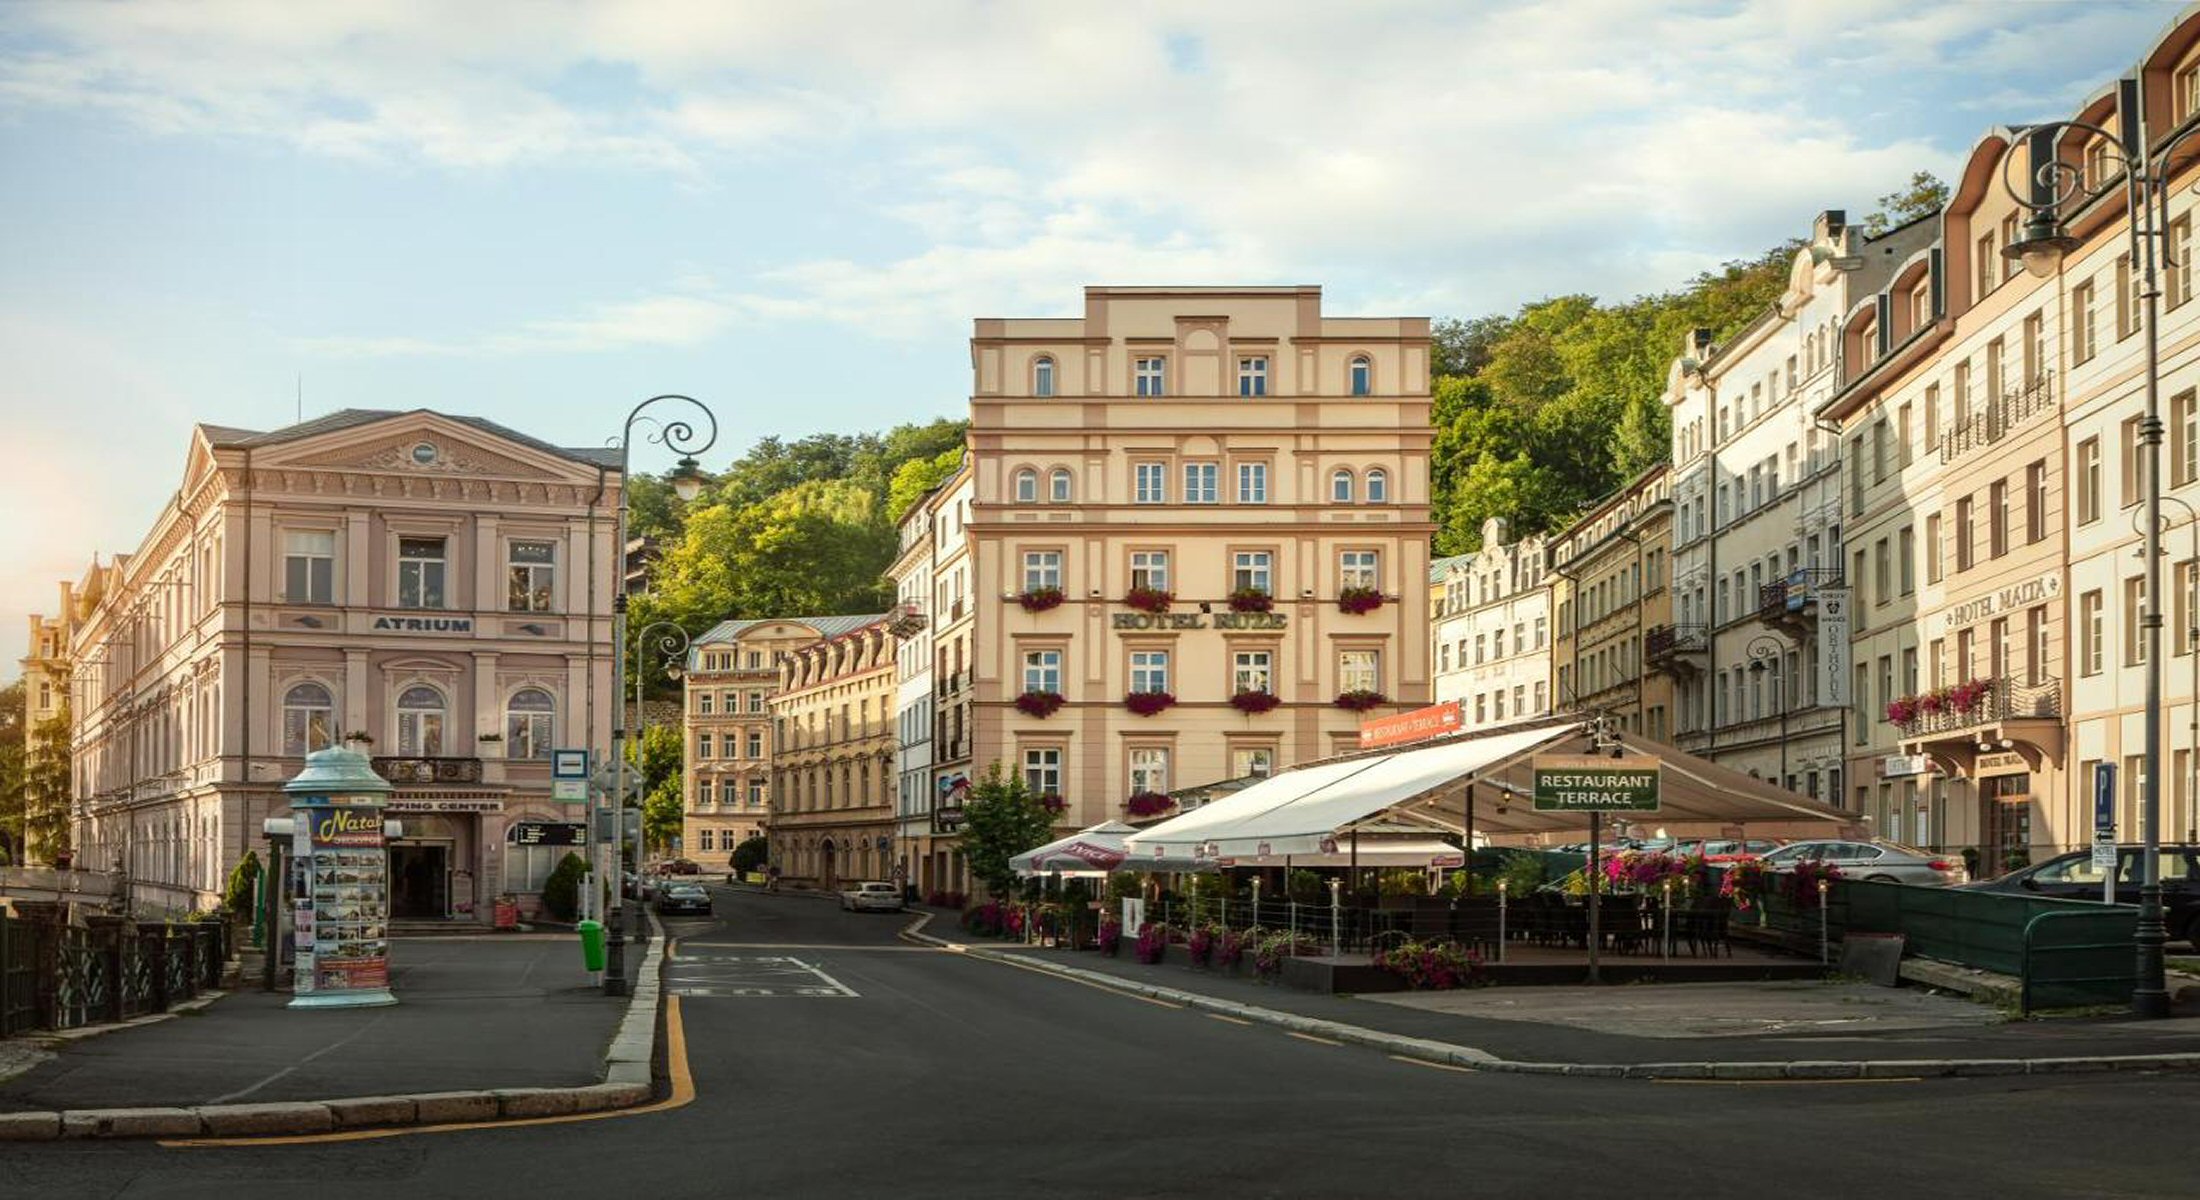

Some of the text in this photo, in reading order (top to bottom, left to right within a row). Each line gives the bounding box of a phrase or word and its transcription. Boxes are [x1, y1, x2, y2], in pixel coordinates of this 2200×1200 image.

[1954, 577, 2047, 626] HOTEL MALTA
[373, 617, 471, 632] ATRIUM
[1113, 613, 1207, 630] HOTEL
[1541, 775, 1652, 788] RESTAURANT
[1556, 792, 1632, 804] TERRACE
[438, 802, 500, 811] CENTER
